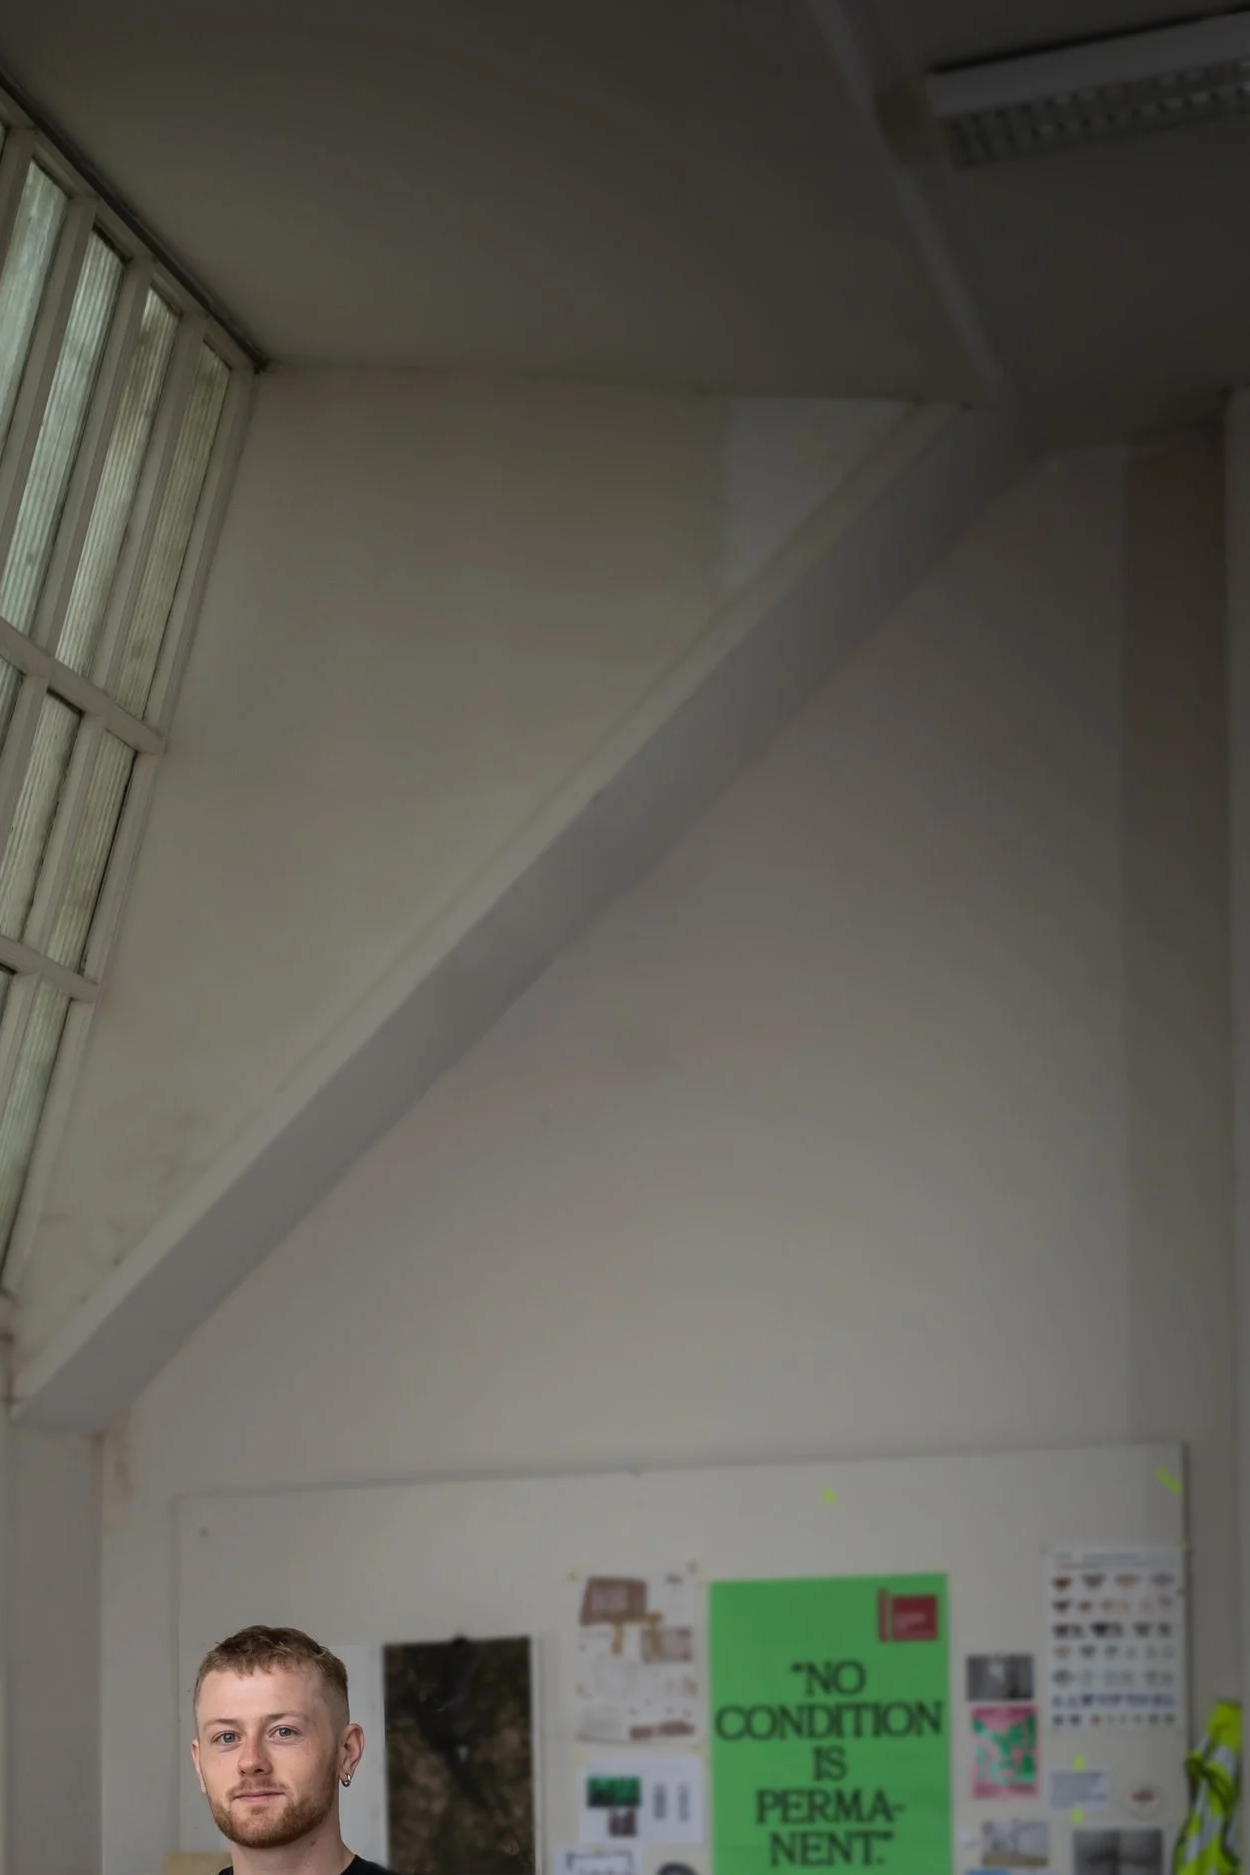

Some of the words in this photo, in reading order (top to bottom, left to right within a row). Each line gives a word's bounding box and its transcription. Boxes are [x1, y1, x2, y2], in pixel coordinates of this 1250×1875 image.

[714, 1700, 943, 1742] CONDITION
[812, 1746, 848, 1782] IS
[755, 1787, 906, 1826] PERMA-
